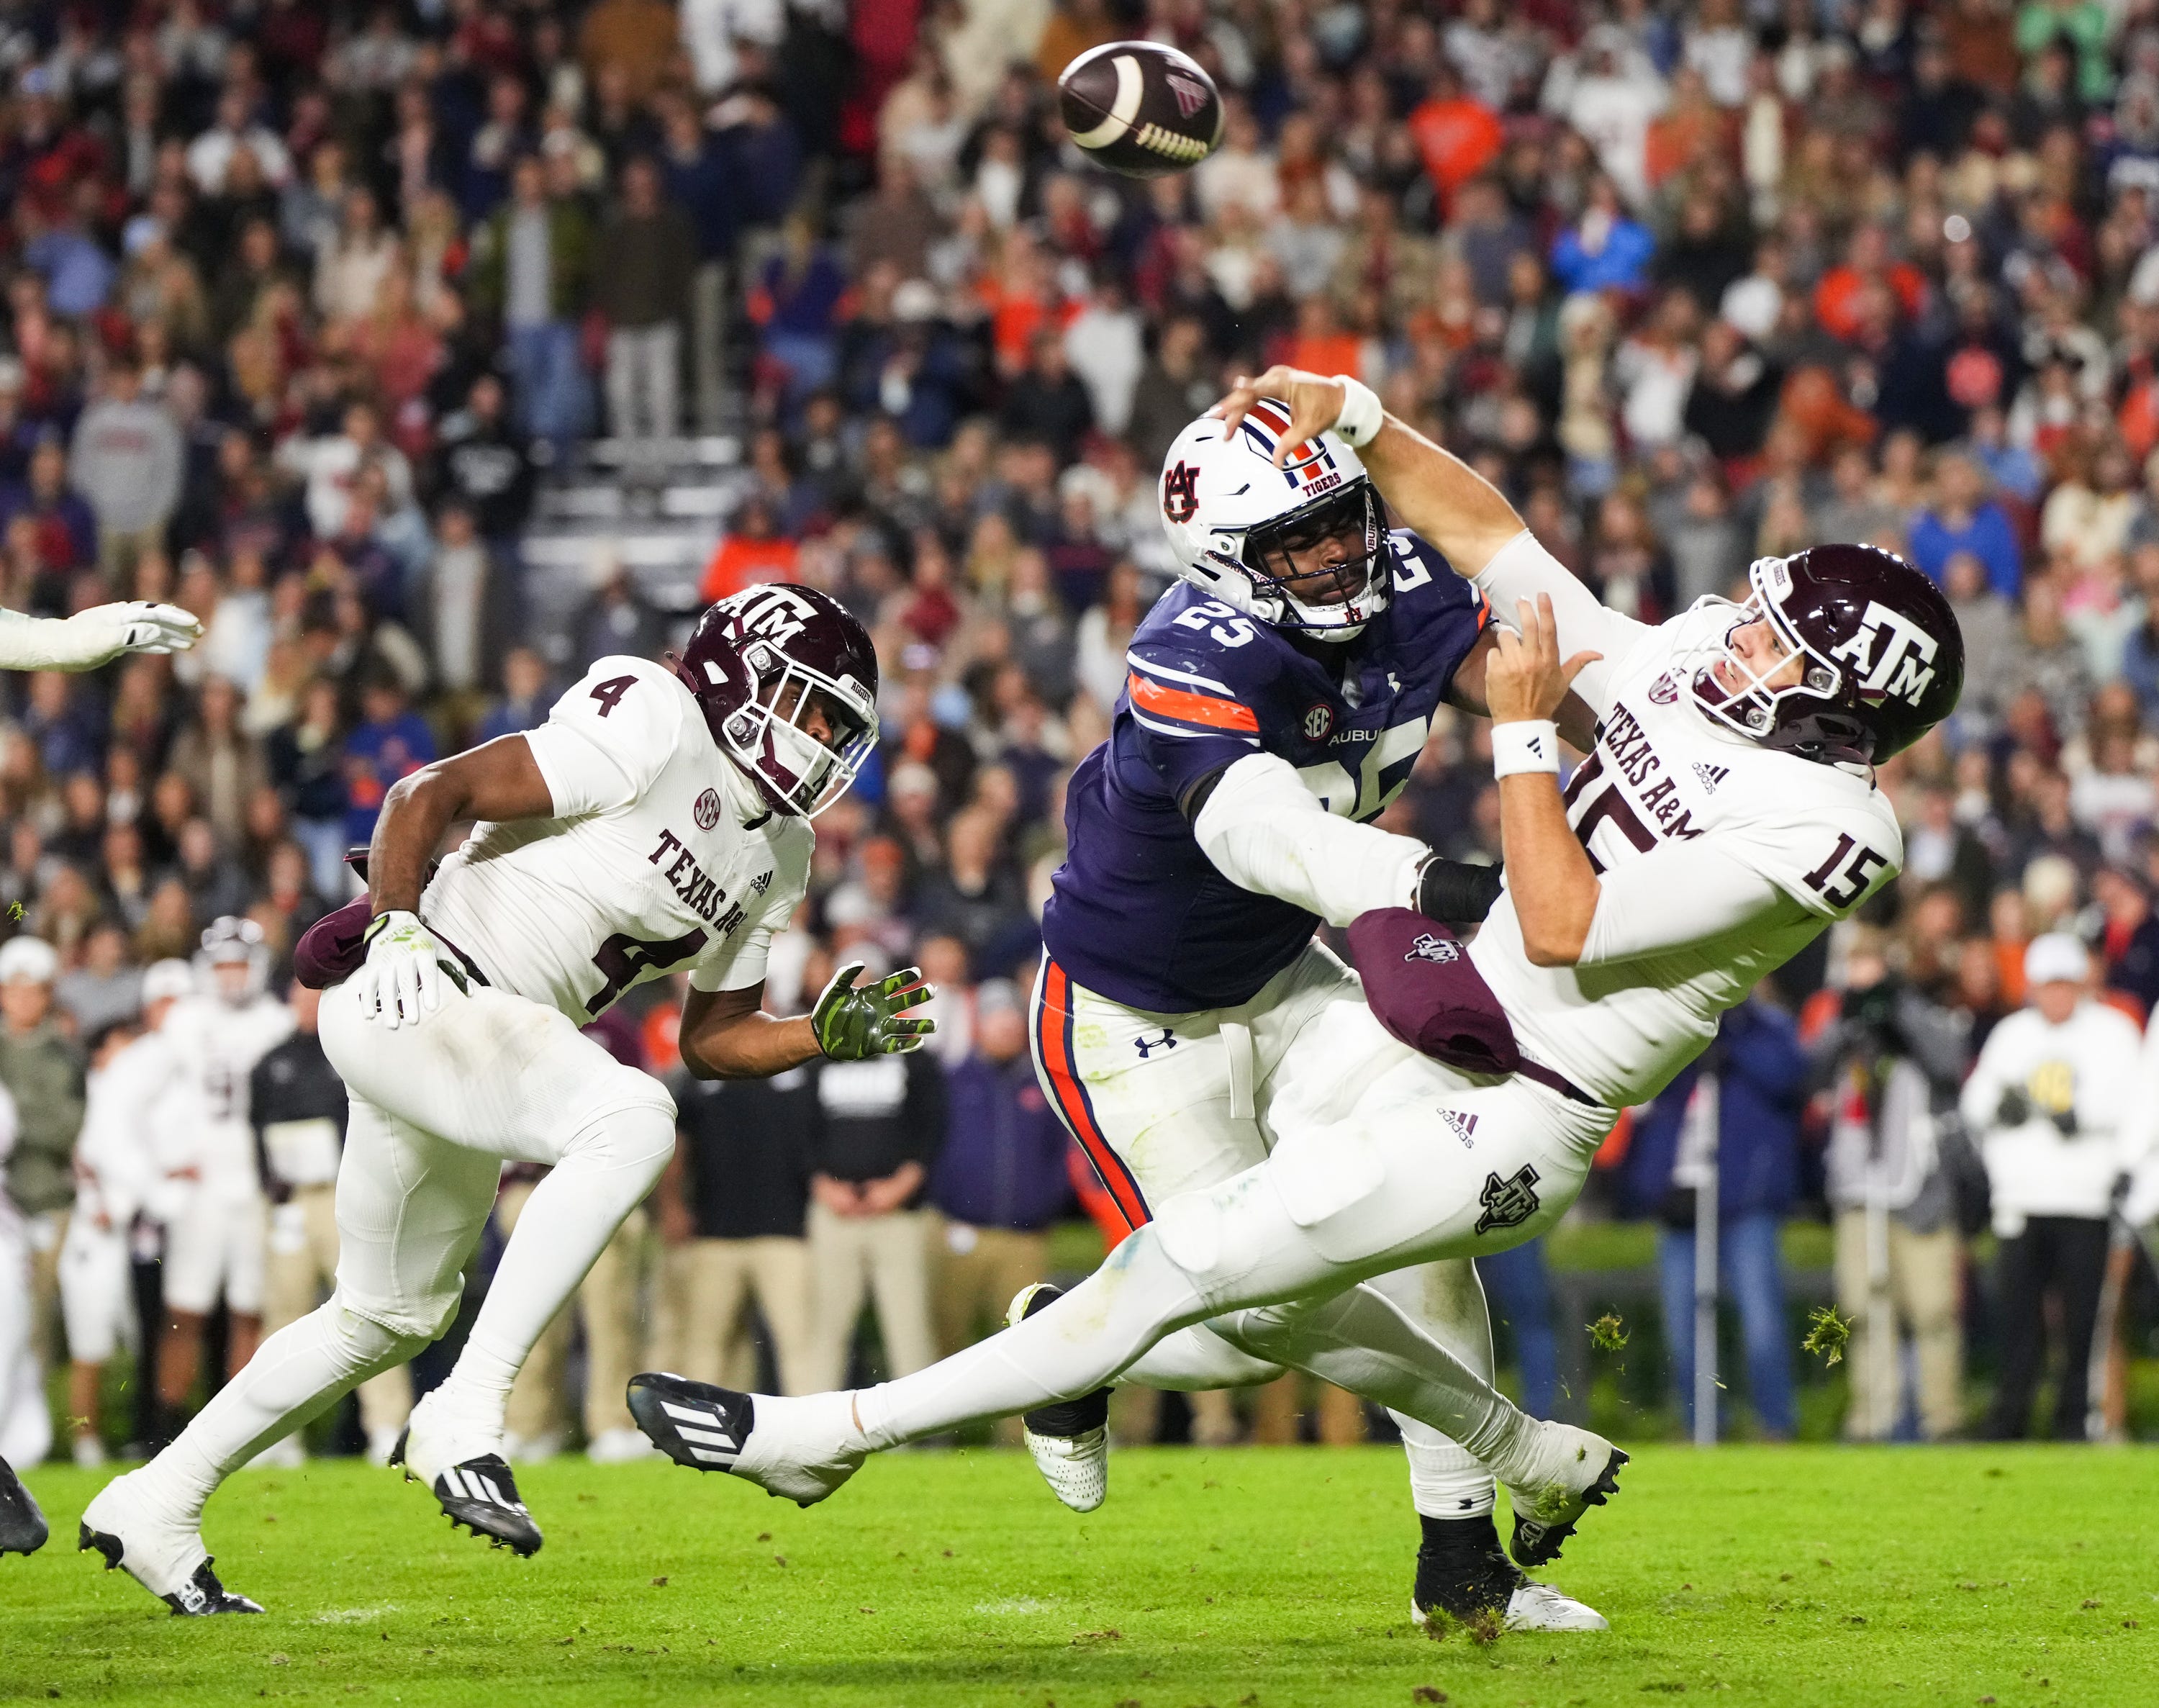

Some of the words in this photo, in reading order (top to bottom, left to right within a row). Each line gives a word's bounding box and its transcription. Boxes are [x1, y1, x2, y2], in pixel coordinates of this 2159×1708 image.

[1302, 472, 1341, 497] TIGERS
[1172, 601, 1258, 649] 25
[589, 674, 639, 718] 4
[850, 681, 871, 705] AGGIES
[1305, 706, 1332, 738] SEC
[1328, 729, 1380, 746] AUBU
[1606, 702, 1661, 787] TEXAS
[1692, 762, 1716, 795] adidas
[695, 789, 720, 830] SEC
[648, 828, 727, 921] TEXAS
[1802, 833, 1888, 909] 15
[585, 927, 709, 1016] 4
[1436, 1106, 1475, 1149] adidas
